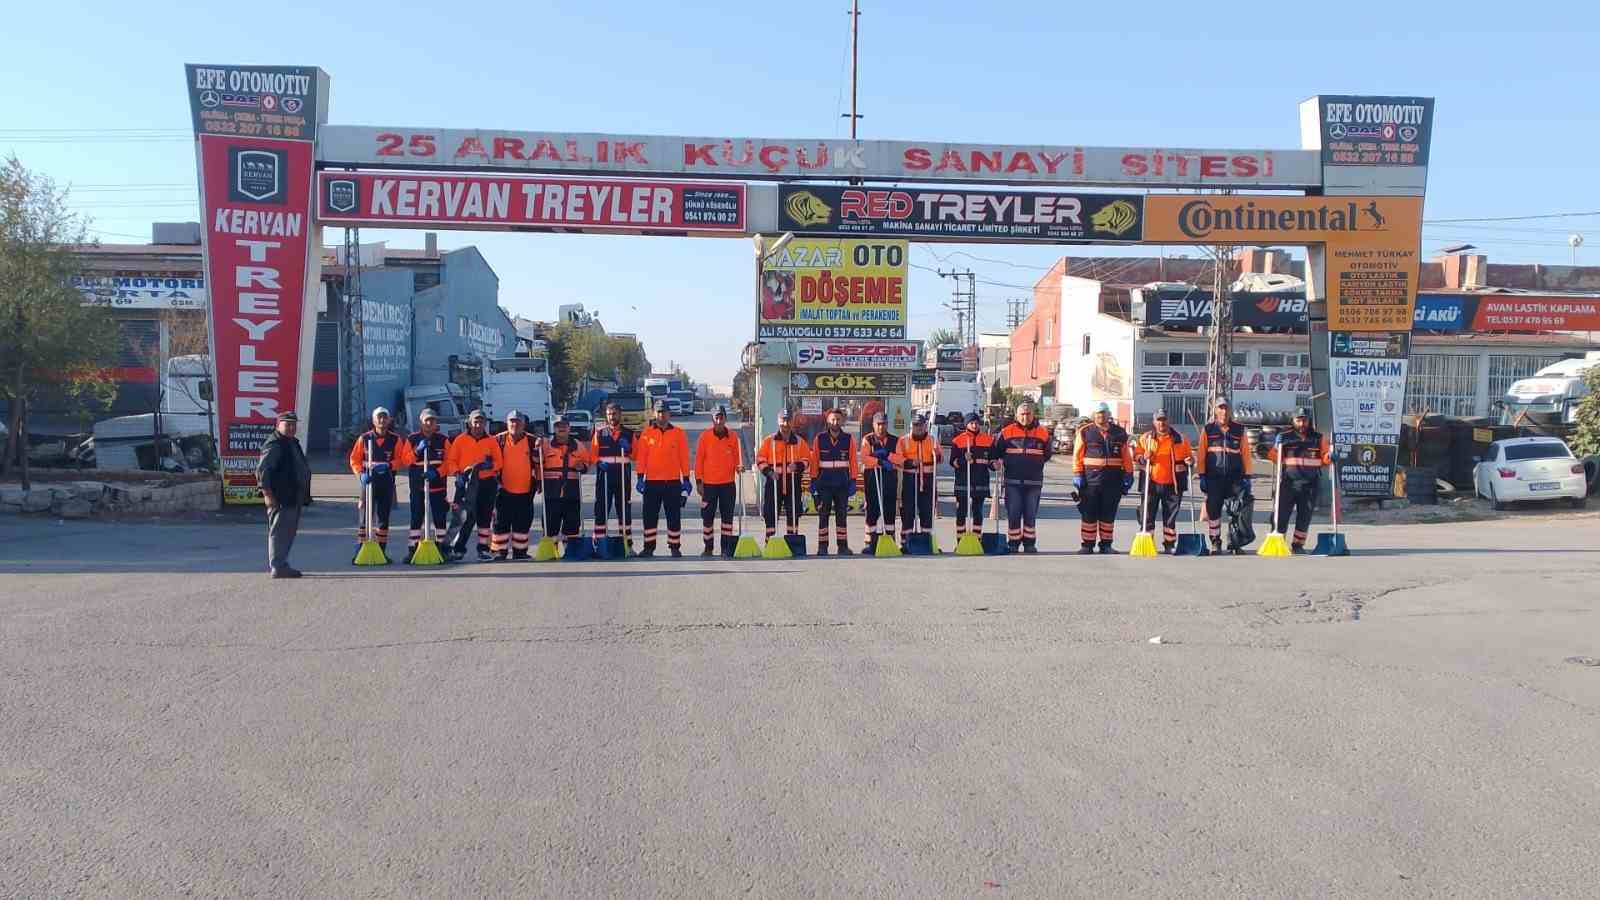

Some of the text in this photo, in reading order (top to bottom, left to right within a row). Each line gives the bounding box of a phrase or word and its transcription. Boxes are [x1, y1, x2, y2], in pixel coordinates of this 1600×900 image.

[196, 68, 309, 95] EFE OTOMOTİV
[1327, 100, 1424, 124] EFE OTOMOTİV
[375, 132, 1274, 178] 25 ARALIK KÜÇÜK SANAYİ SİTESİ
[370, 179, 674, 224] KERVAN TREYLER
[840, 191, 1082, 225] RED TREYLER
[214, 207, 302, 237] KERVAN
[883, 221, 913, 230] MAKİNA
[944, 223, 977, 232] TİCARET
[1178, 200, 1357, 238] Continental
[853, 244, 903, 268] OTO
[800, 270, 902, 307] DÖŞEME
[1488, 301, 1595, 314] AVAN LASTİK KAPLAMA
[232, 239, 283, 418] TREYLER
[825, 327, 831, 337] 0
[833, 327, 851, 338] 537
[853, 327, 872, 338] 633
[875, 328, 887, 338] 42
[889, 328, 902, 338] 64
[815, 374, 876, 389] GÖK
[1346, 361, 1402, 376] İBRAHİM
